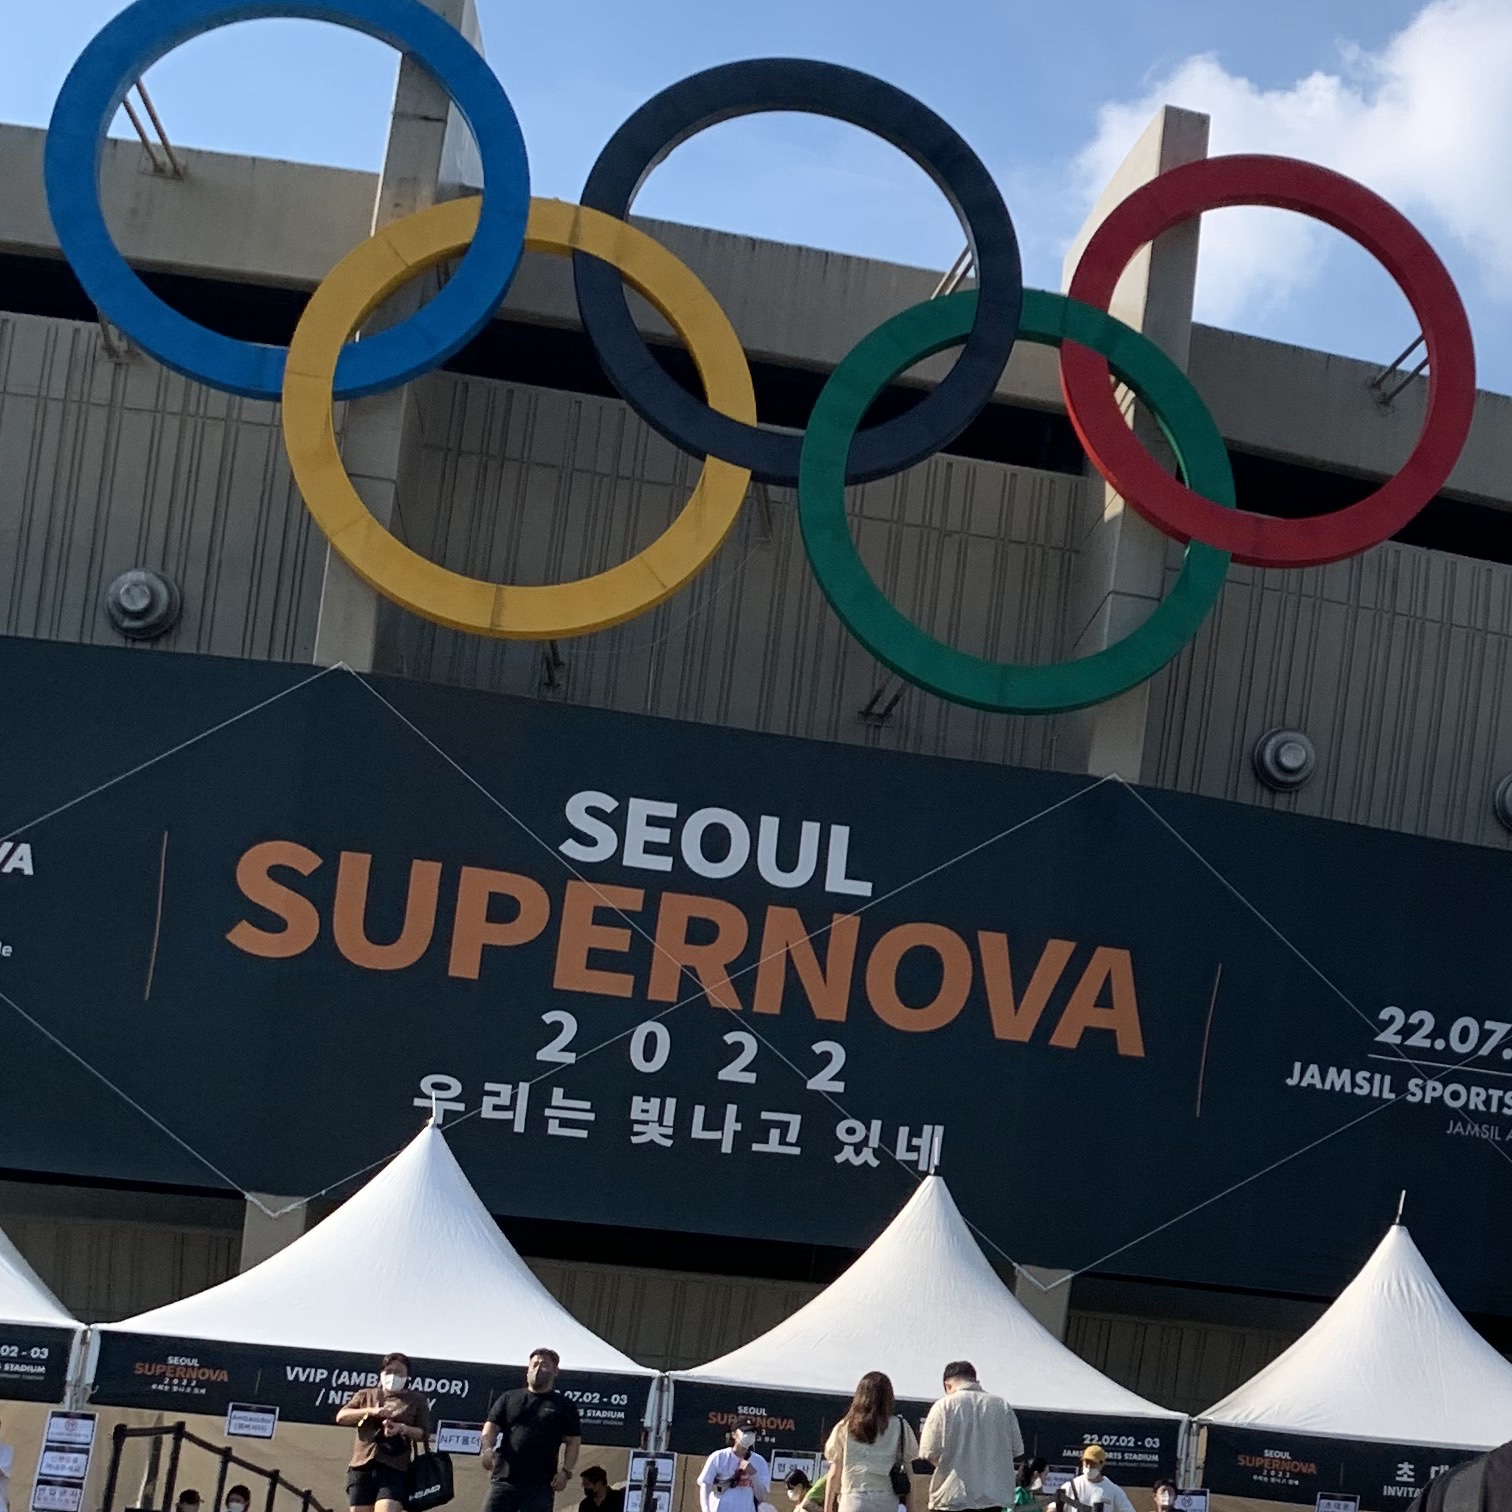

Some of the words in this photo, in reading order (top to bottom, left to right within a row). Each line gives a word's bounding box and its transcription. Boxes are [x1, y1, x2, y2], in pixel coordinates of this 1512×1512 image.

[558, 790, 873, 897] SEOUL
[226, 840, 1145, 1057] SUPERNOVA
[1286, 1061, 1396, 1100] JAMSIL
[413, 1074, 596, 1138] 우리는
[629, 1096, 802, 1154] 빛나고
[835, 1117, 945, 1171] 있네
[1446, 1119, 1501, 1141] JAMSIL
[30, 1346, 49, 1359] 03
[4, 1362, 46, 1374] STADIUM
[167, 1355, 200, 1367] SEOUL
[133, 1361, 230, 1383] SUPERNOVA
[285, 1365, 329, 1384] VVIP
[332, 1369, 470, 1399] (AMBADOR)
[611, 1393, 628, 1405] 03
[586, 1408, 625, 1420] STADIUM
[737, 1405, 768, 1417] SEOUL
[707, 1411, 796, 1432] SUPNOVA
[1083, 1433, 1135, 1448] 22.07.02
[1144, 1437, 1160, 1449] 03
[1062, 1449, 1084, 1458] JAMS
[1123, 1452, 1159, 1462] STADIUM
[1264, 1449, 1291, 1460] SEOUL
[1237, 1454, 1317, 1475] SUPERNOVA
[1383, 1484, 1423, 1498] INVITA
